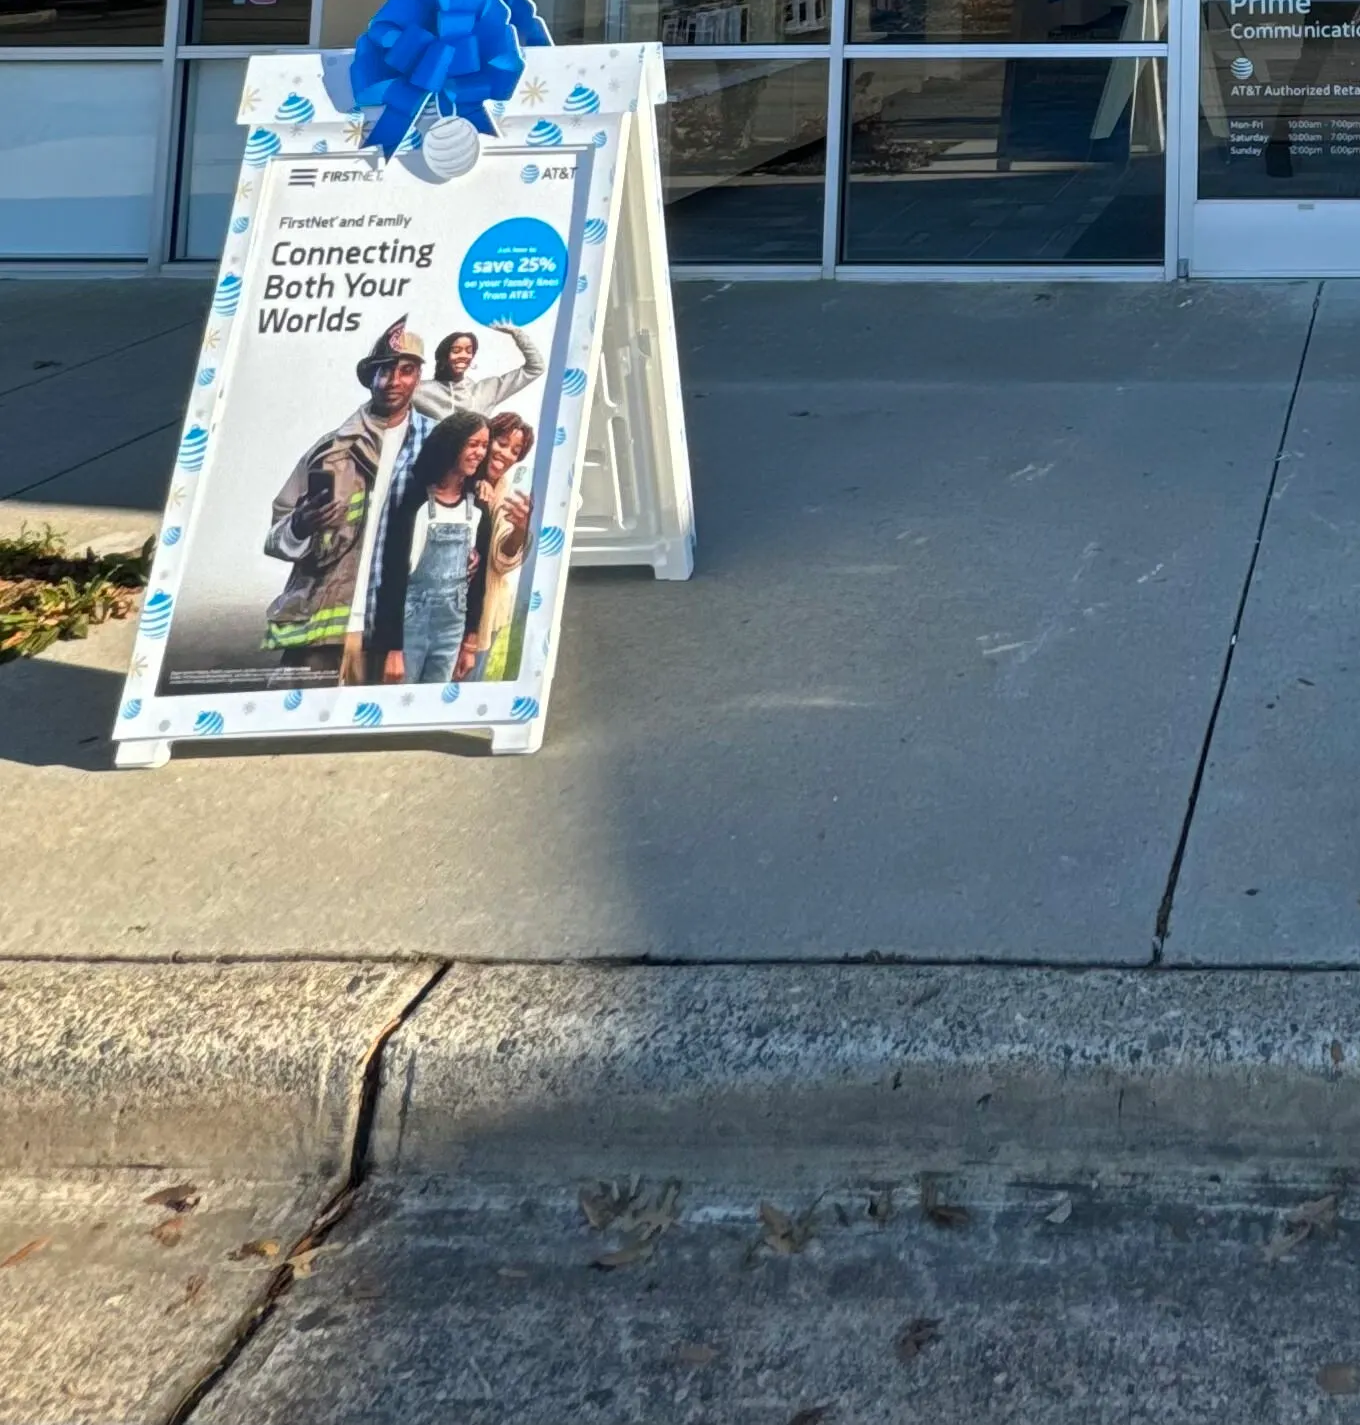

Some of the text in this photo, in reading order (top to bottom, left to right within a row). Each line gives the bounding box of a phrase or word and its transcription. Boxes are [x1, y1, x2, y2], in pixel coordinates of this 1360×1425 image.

[1231, 85, 1262, 96] AT&T
[1264, 84, 1330, 96] Authorized
[1230, 133, 1269, 144] Saturday
[1230, 146, 1262, 156] Sunday
[541, 165, 578, 180] AT&T
[339, 215, 365, 227] and
[368, 214, 412, 229] Family
[271, 238, 435, 268] Connecting
[472, 256, 557, 274] save 25%
[263, 272, 411, 301] Both Your
[503, 278, 535, 289] family
[483, 290, 507, 300] from
[257, 306, 362, 334] Worlds
